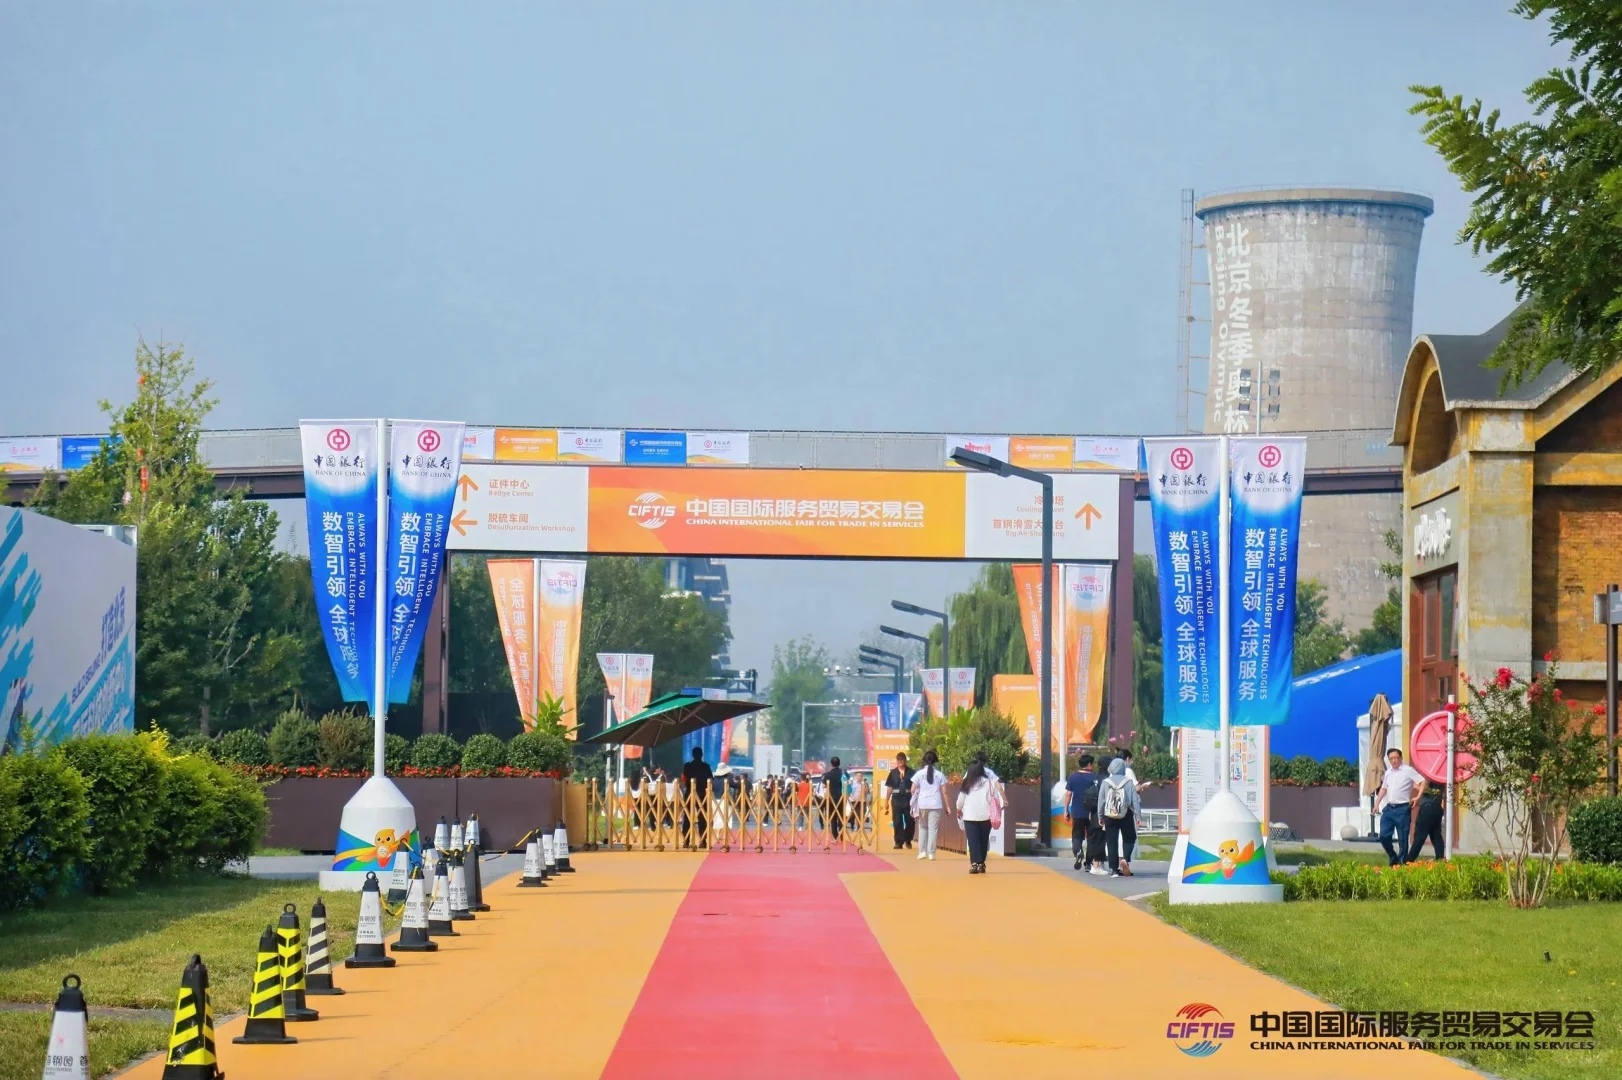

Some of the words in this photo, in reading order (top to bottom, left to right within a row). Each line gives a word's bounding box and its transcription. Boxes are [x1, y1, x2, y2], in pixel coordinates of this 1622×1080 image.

[314, 455, 365, 469] 中国银行
[402, 454, 453, 470] 中国银行
[489, 479, 530, 490] 证件中心
[1158, 474, 1208, 487] 中国银行
[1243, 471, 1293, 485] 中国银行
[488, 490, 511, 498] Badge
[1034, 495, 1065, 506] 冷塔
[488, 513, 529, 524] 脱硫车间
[628, 504, 677, 518] CIFTIS
[686, 497, 925, 520] 中国国际服务贸易交易会
[346, 512, 356, 554] EMBRACE
[358, 512, 366, 548] ALWAYS
[422, 513, 433, 554] EMBRACE
[433, 514, 444, 548] ALWAYS
[541, 525, 576, 533] Workshop
[686, 518, 717, 526] CHINA
[718, 518, 794, 527] INTERNATIONAL
[795, 519, 815, 527] FAIR
[816, 519, 836, 528] FOR
[838, 520, 867, 528] TRADE
[869, 520, 881, 528] IN
[882, 520, 925, 529] SERVICES
[992, 519, 1065, 530] 首钢滑雪大台
[1005, 530, 1017, 538] Big
[322, 511, 347, 598] 数智引领
[394, 512, 421, 597] 数智引领
[1191, 530, 1202, 571] EMBRACE
[1201, 530, 1211, 565] ALWAYS
[1267, 527, 1277, 568] EMBRACE
[1279, 528, 1288, 562] ALWAYS
[429, 552, 439, 576] WITH
[1169, 530, 1195, 615] 数智引领
[1242, 528, 1266, 612] 数智引领
[358, 578, 366, 599] YOU
[412, 558, 428, 615] INTELLIGENT
[425, 579, 434, 597] YOU
[1205, 568, 1213, 593] WITH
[1277, 566, 1287, 590] WITH
[1195, 575, 1205, 632] INTELLIGENT
[1206, 596, 1214, 614] YOU
[1264, 573, 1275, 630] INTELLIGENT
[1276, 593, 1286, 611] YOU
[1176, 621, 1199, 703] 全球服务
[1198, 636, 1210, 704] TECHNOLOGIES
[1238, 618, 1260, 702] 全球服务
[1259, 633, 1272, 700] TECHNOLOGIES
